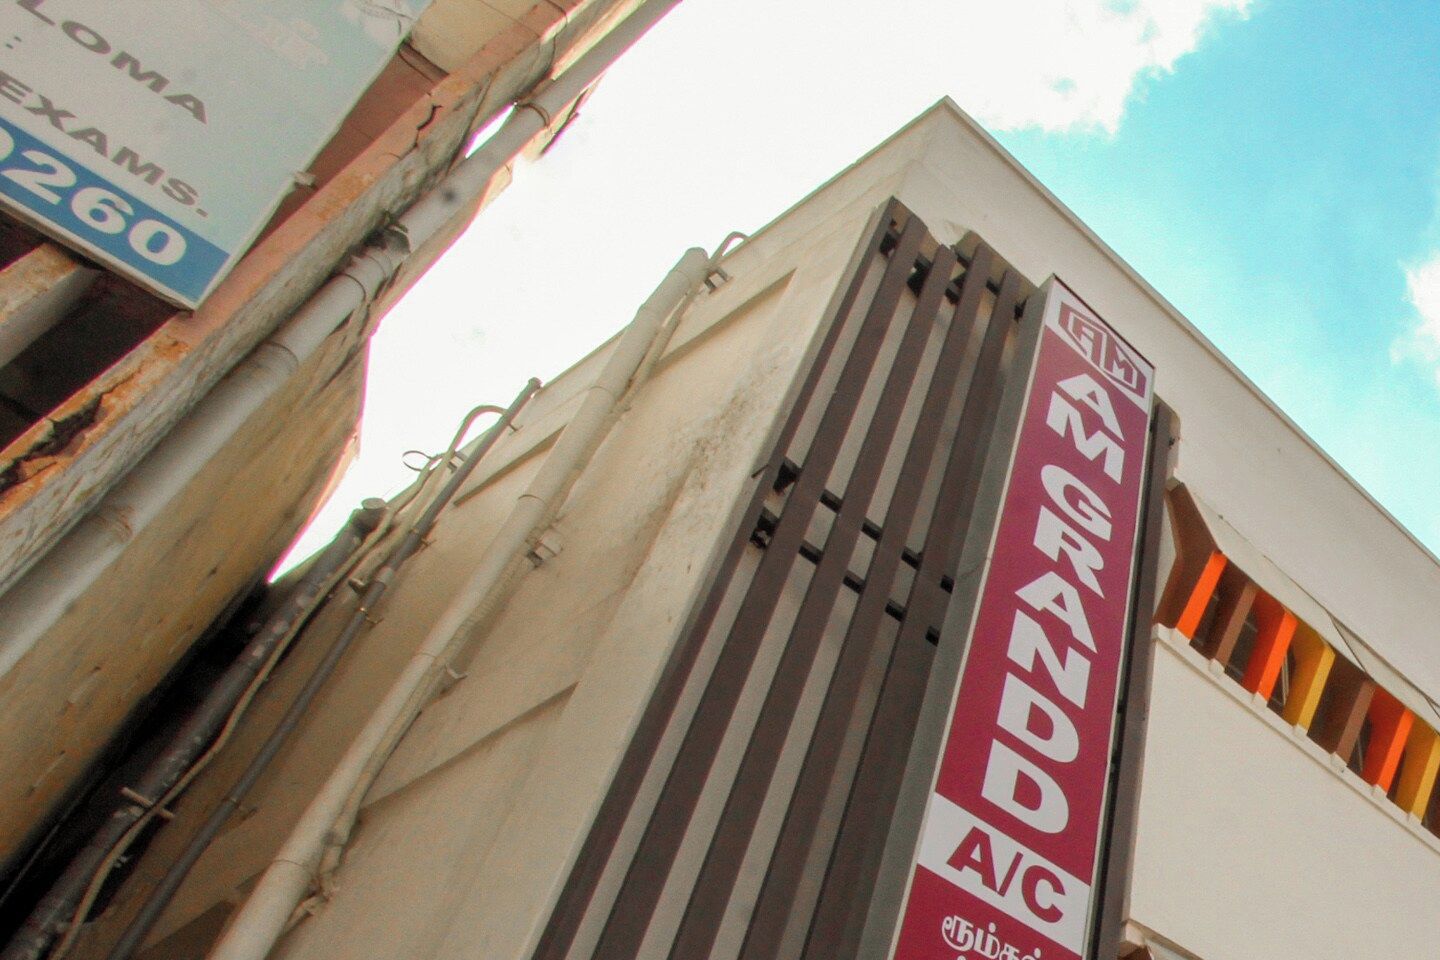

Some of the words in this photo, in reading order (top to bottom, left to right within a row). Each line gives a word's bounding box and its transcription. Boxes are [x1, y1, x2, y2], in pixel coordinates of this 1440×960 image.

[0, 126, 187, 266] 260
[1046, 373, 1125, 484] AM
[981, 464, 1112, 834] GRANDD
[946, 826, 1066, 924] A/C
